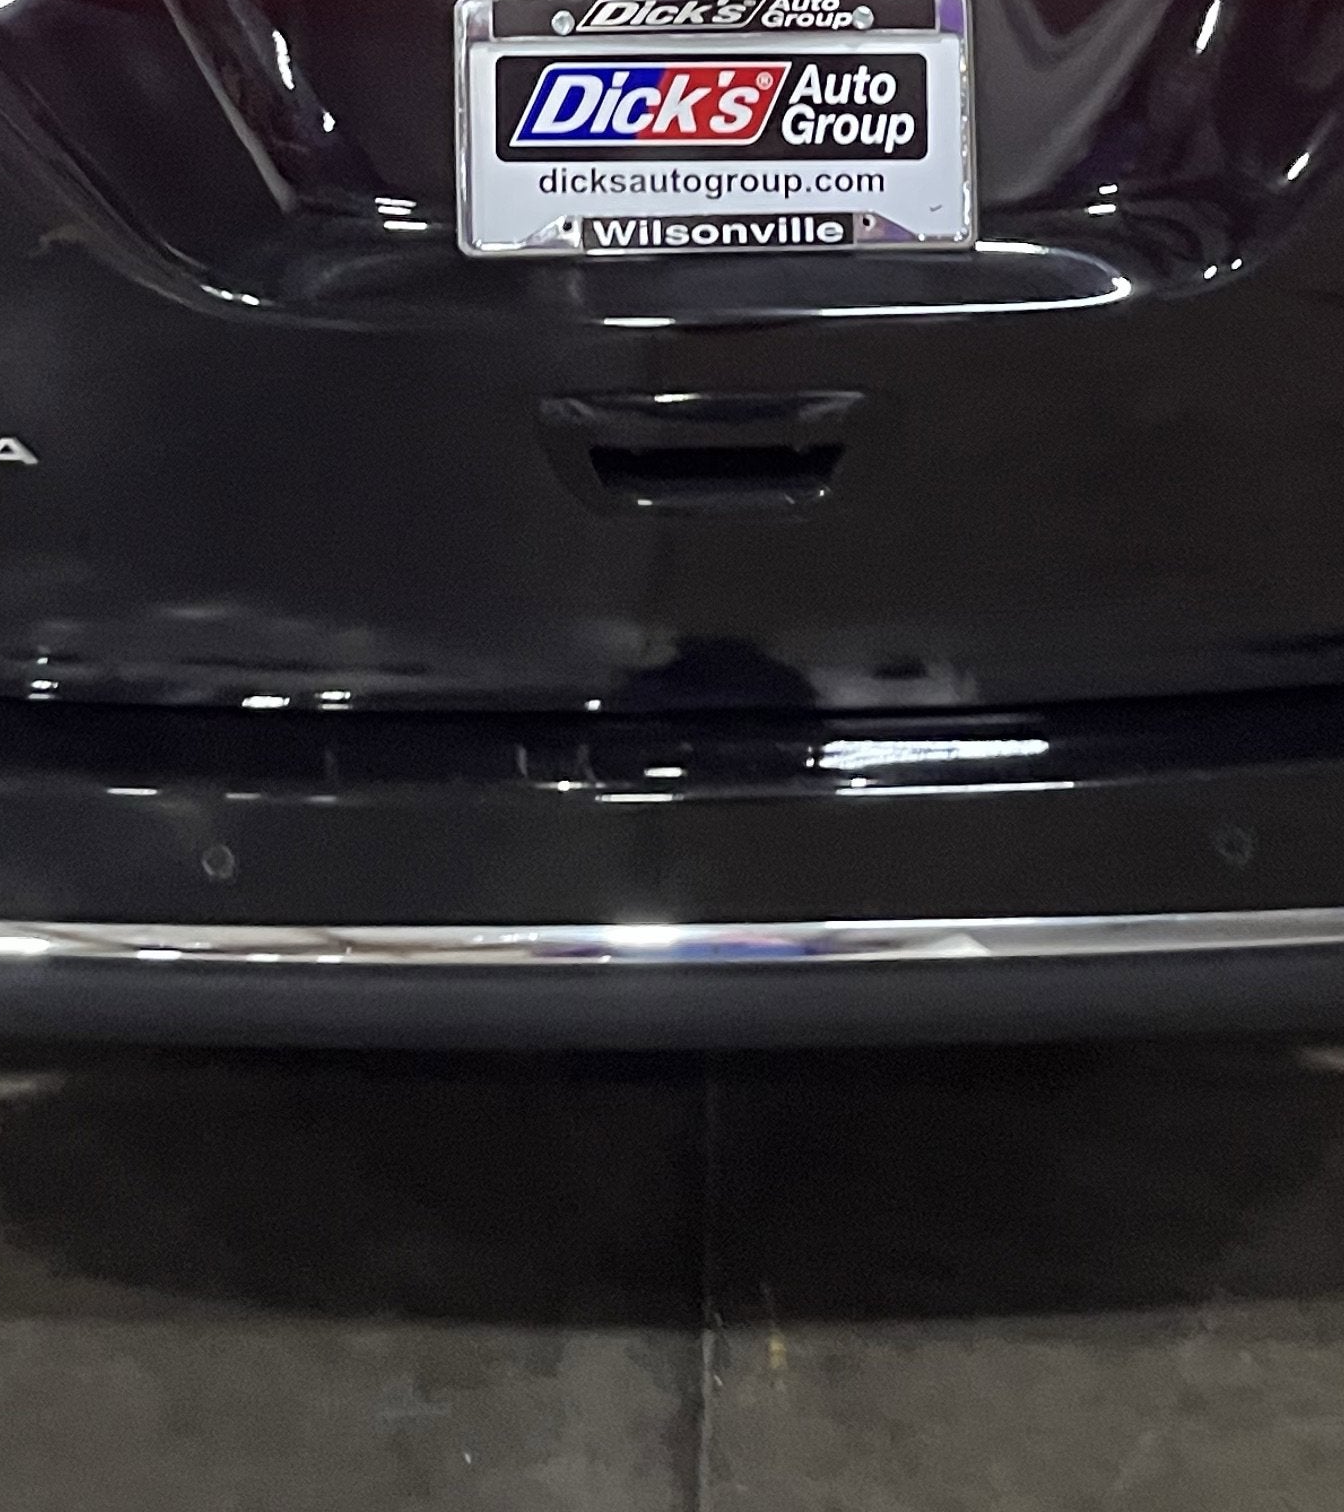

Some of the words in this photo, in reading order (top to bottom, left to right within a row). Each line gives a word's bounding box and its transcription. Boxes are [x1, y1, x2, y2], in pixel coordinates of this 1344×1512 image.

[761, 9, 853, 30] Group
[531, 70, 759, 134] Dick's
[789, 63, 897, 106] Auto
[781, 103, 915, 154] Group
[539, 167, 886, 200] dicksautogroup.com
[592, 215, 845, 247] Wilsonville
